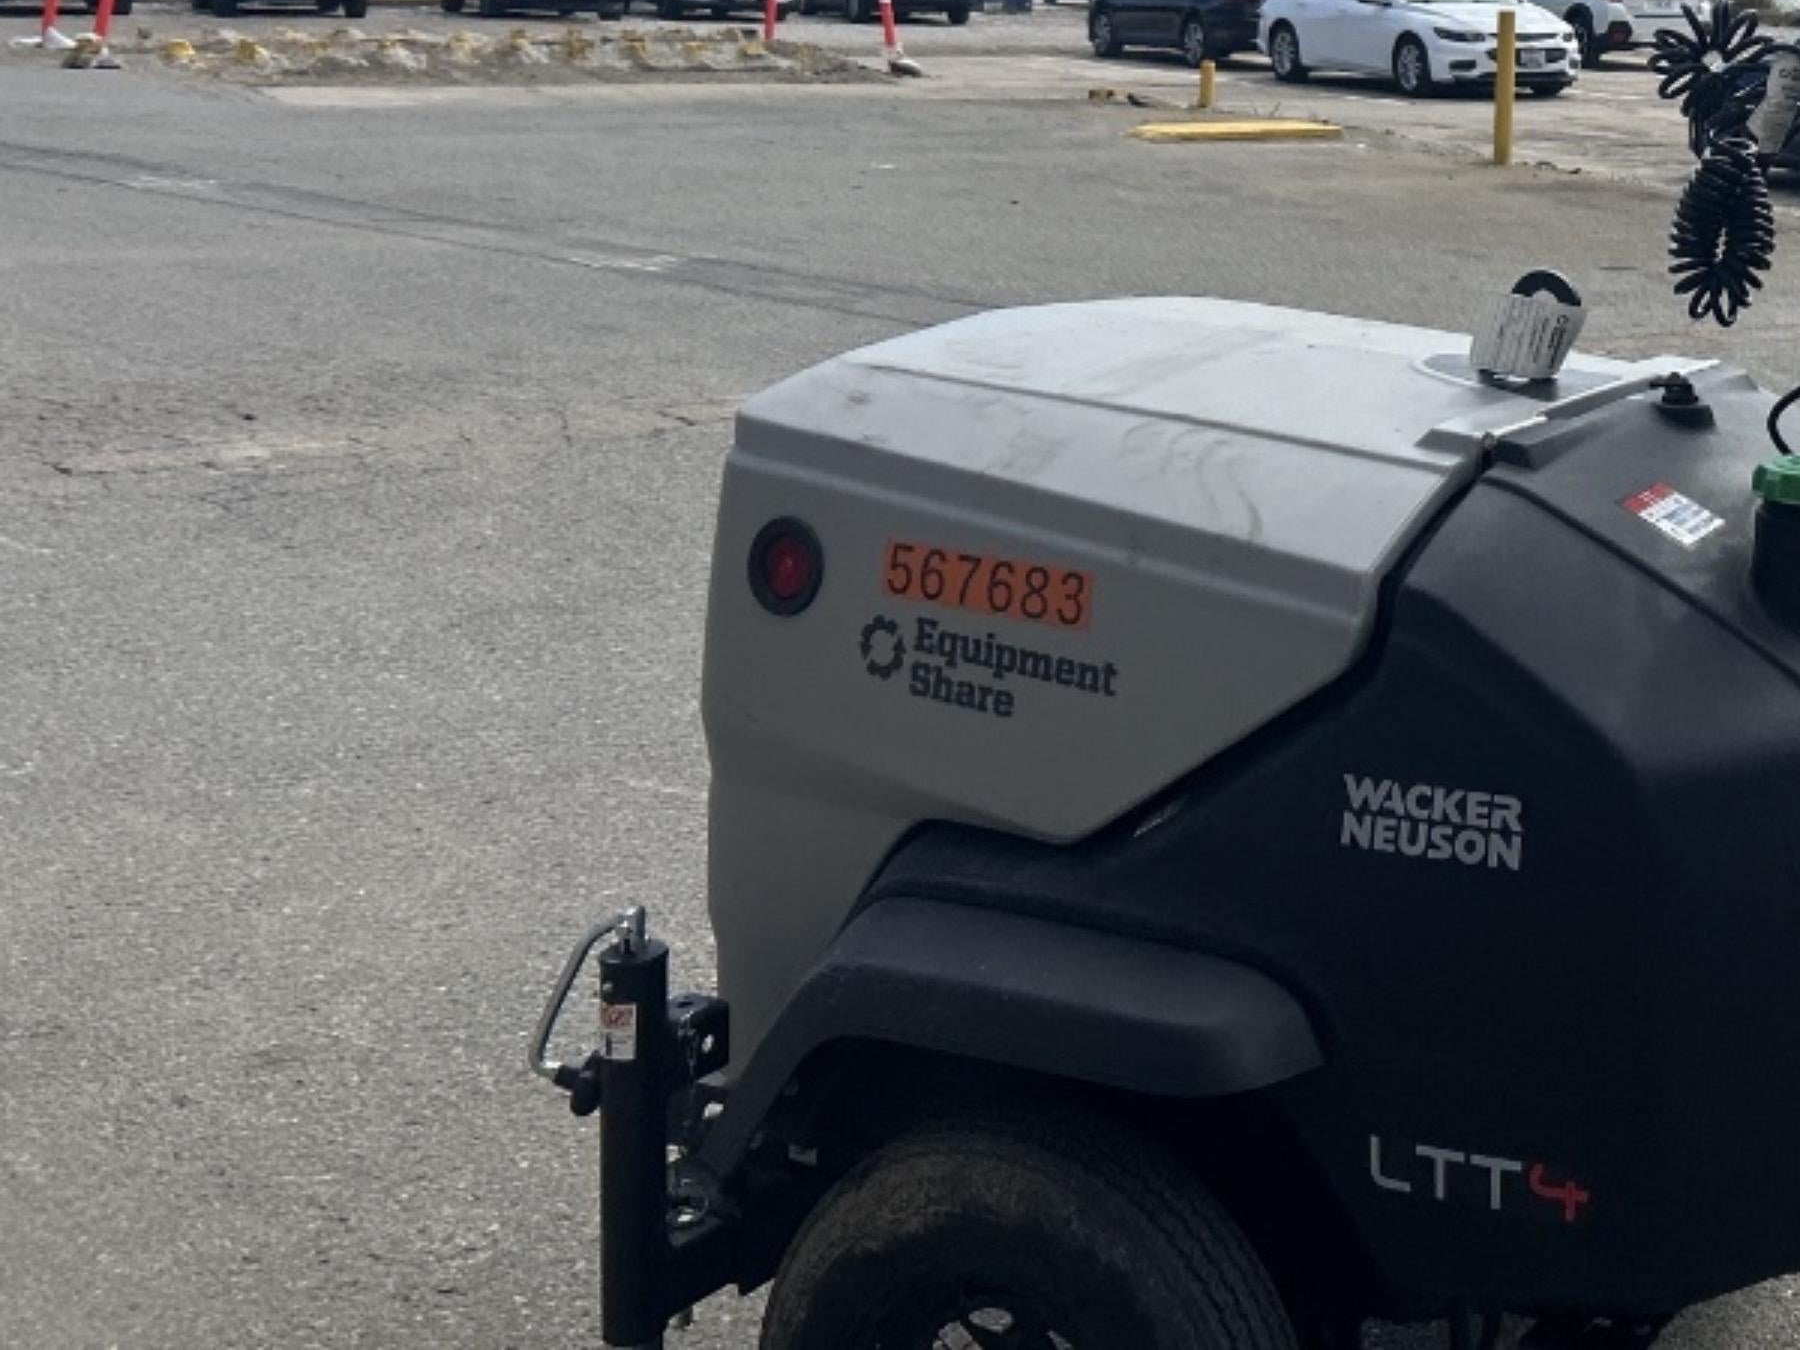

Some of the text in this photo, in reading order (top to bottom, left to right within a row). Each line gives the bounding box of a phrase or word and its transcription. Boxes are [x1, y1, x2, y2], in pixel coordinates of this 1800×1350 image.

[887, 542, 1085, 626] 567683
[909, 660, 1016, 718] Share
[914, 617, 1118, 697] Equipment
[1343, 772, 1525, 833] WACKER
[1340, 810, 1523, 871] NEUSON
[1370, 1134, 1591, 1222] LTT4
